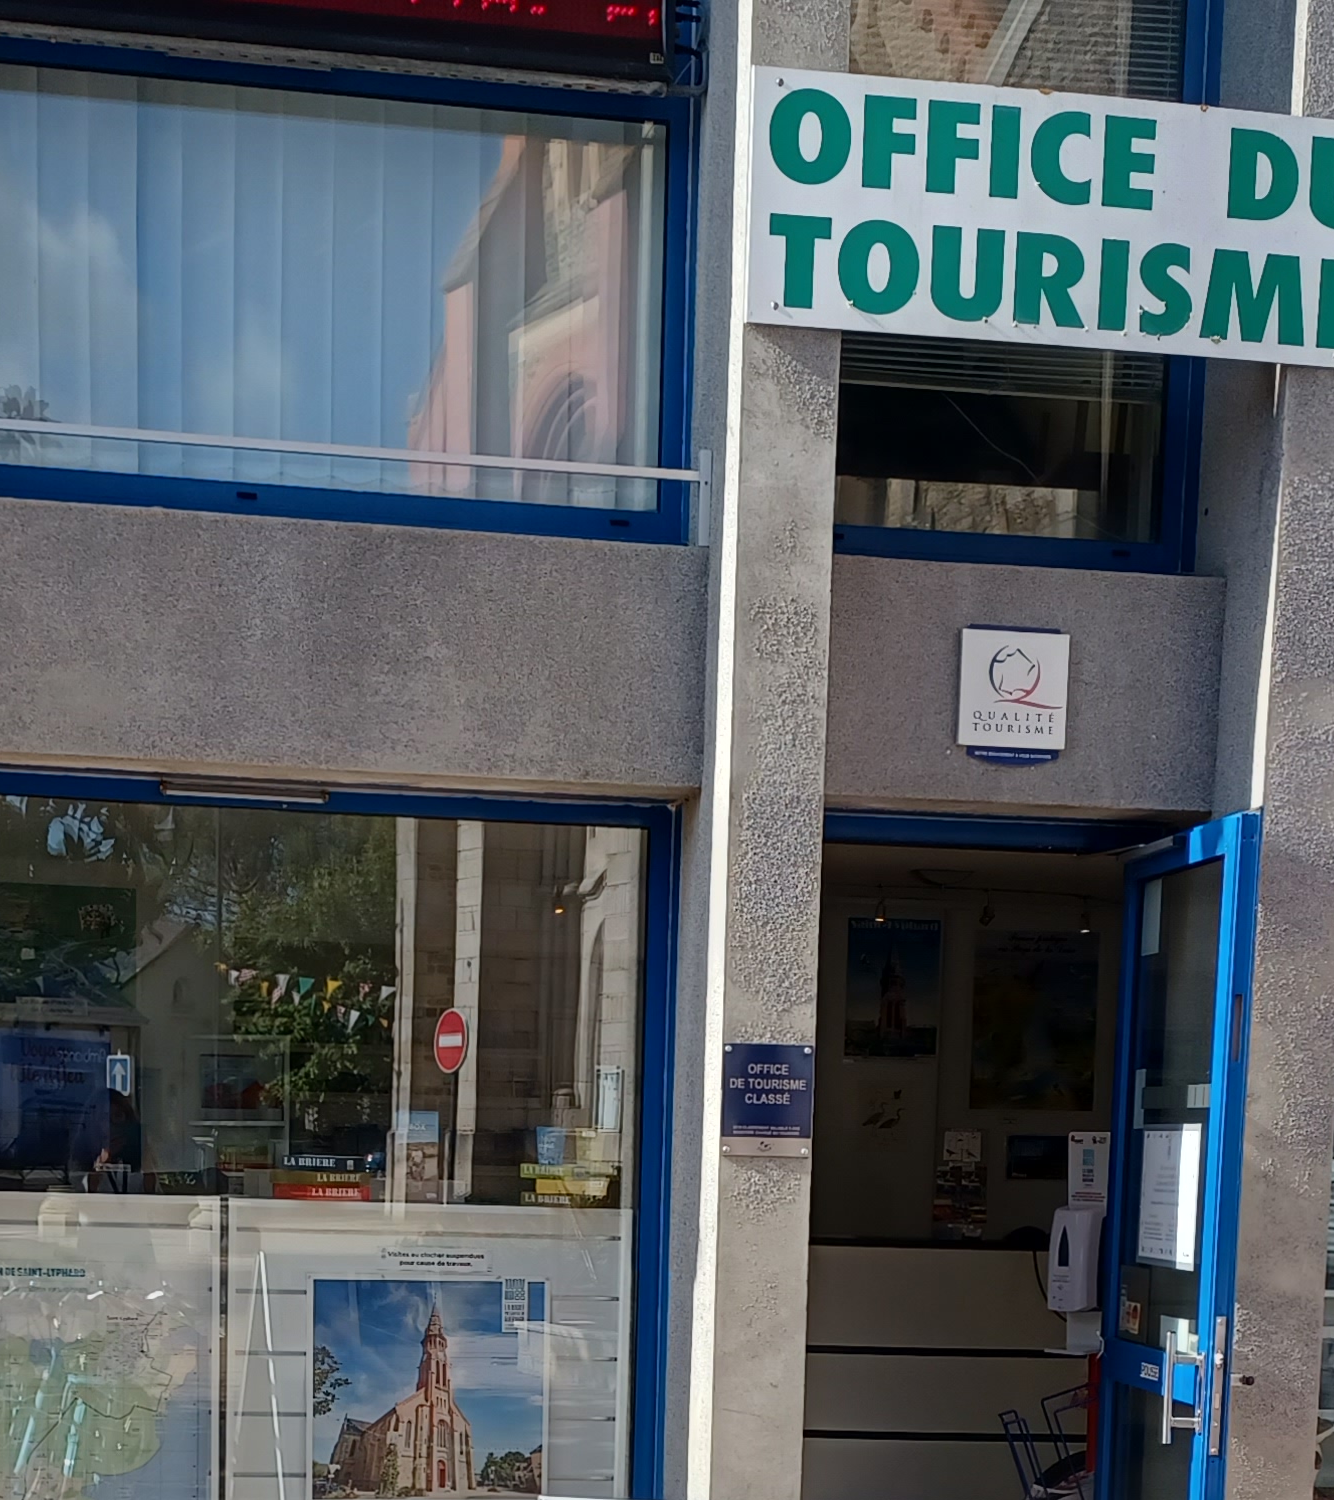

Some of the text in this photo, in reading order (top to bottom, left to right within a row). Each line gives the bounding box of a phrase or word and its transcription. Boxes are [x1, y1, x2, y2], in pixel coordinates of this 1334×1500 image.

[769, 88, 1158, 211] OFFICE
[973, 711, 1054, 723] QUALITÉ
[973, 723, 1053, 735] TOURISME
[748, 1063, 789, 1075] OFFICE
[729, 1078, 807, 1090] DE TOURISME
[745, 1092, 791, 1104] CLASSÉ
[284, 1157, 296, 1166] LA
[317, 1173, 327, 1182] LA
[312, 1188, 324, 1196] LA
[525, 1194, 536, 1203] LA
[5, 1267, 16, 1277] DE
[17, 1267, 86, 1278] SAINT-LYPHARD
